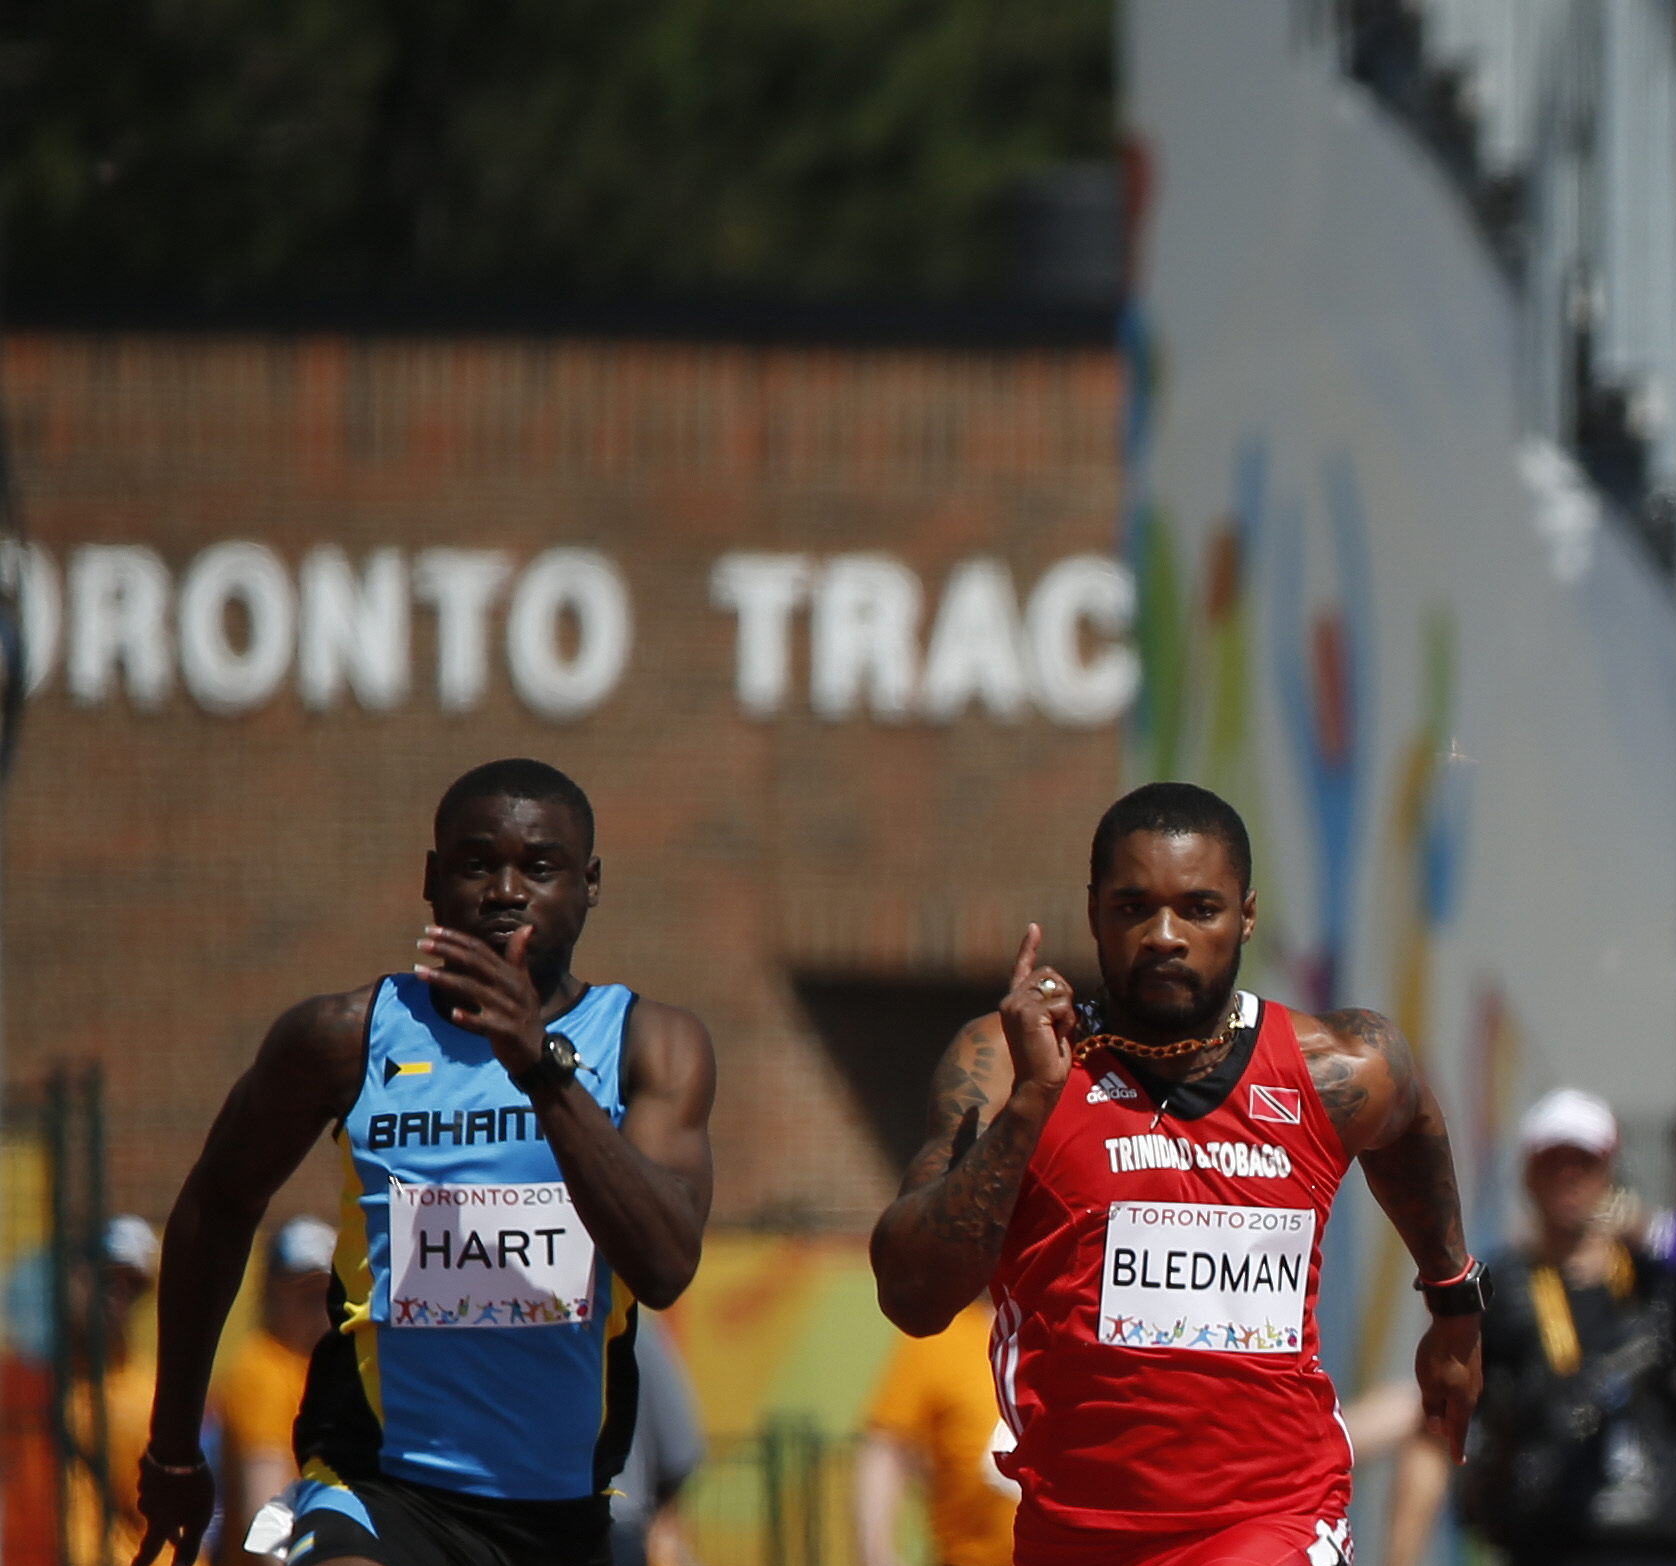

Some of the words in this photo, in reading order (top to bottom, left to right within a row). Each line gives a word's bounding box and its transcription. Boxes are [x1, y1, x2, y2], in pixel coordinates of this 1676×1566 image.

[369, 1105, 547, 1150] BAHAM
[1105, 1134, 1194, 1173] TRINIDAD
[1195, 1143, 1213, 1169] &
[1207, 1142, 1292, 1178] TOBAGO
[407, 1188, 519, 1206] TORONTO
[522, 1187, 572, 1206] 201
[1128, 1207, 1245, 1230] TORONTO
[1248, 1213, 1301, 1231] 2015
[419, 1228, 566, 1270] HART
[1112, 1248, 1302, 1293] BLEDMAN
